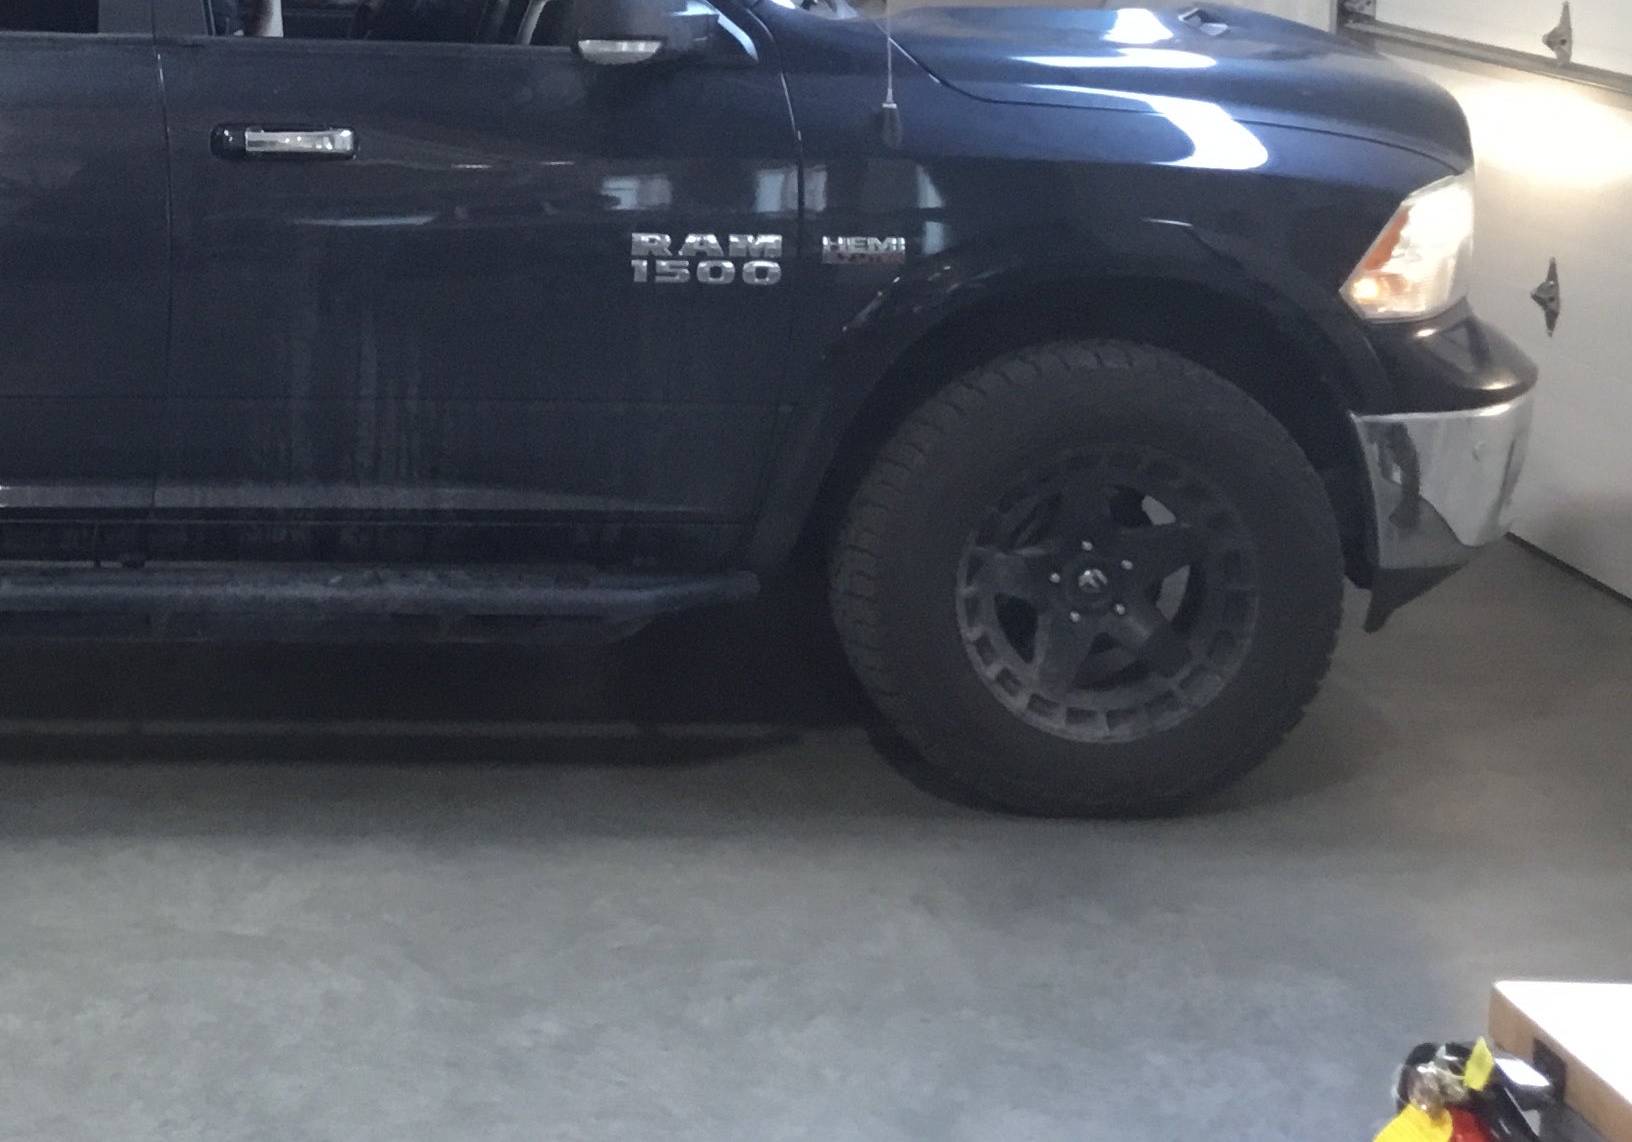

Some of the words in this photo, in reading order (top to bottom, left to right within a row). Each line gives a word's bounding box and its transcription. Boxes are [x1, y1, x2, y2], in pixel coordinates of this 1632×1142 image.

[631, 232, 783, 257] RAM
[821, 235, 907, 253] HEMI
[631, 259, 783, 285] 1500
